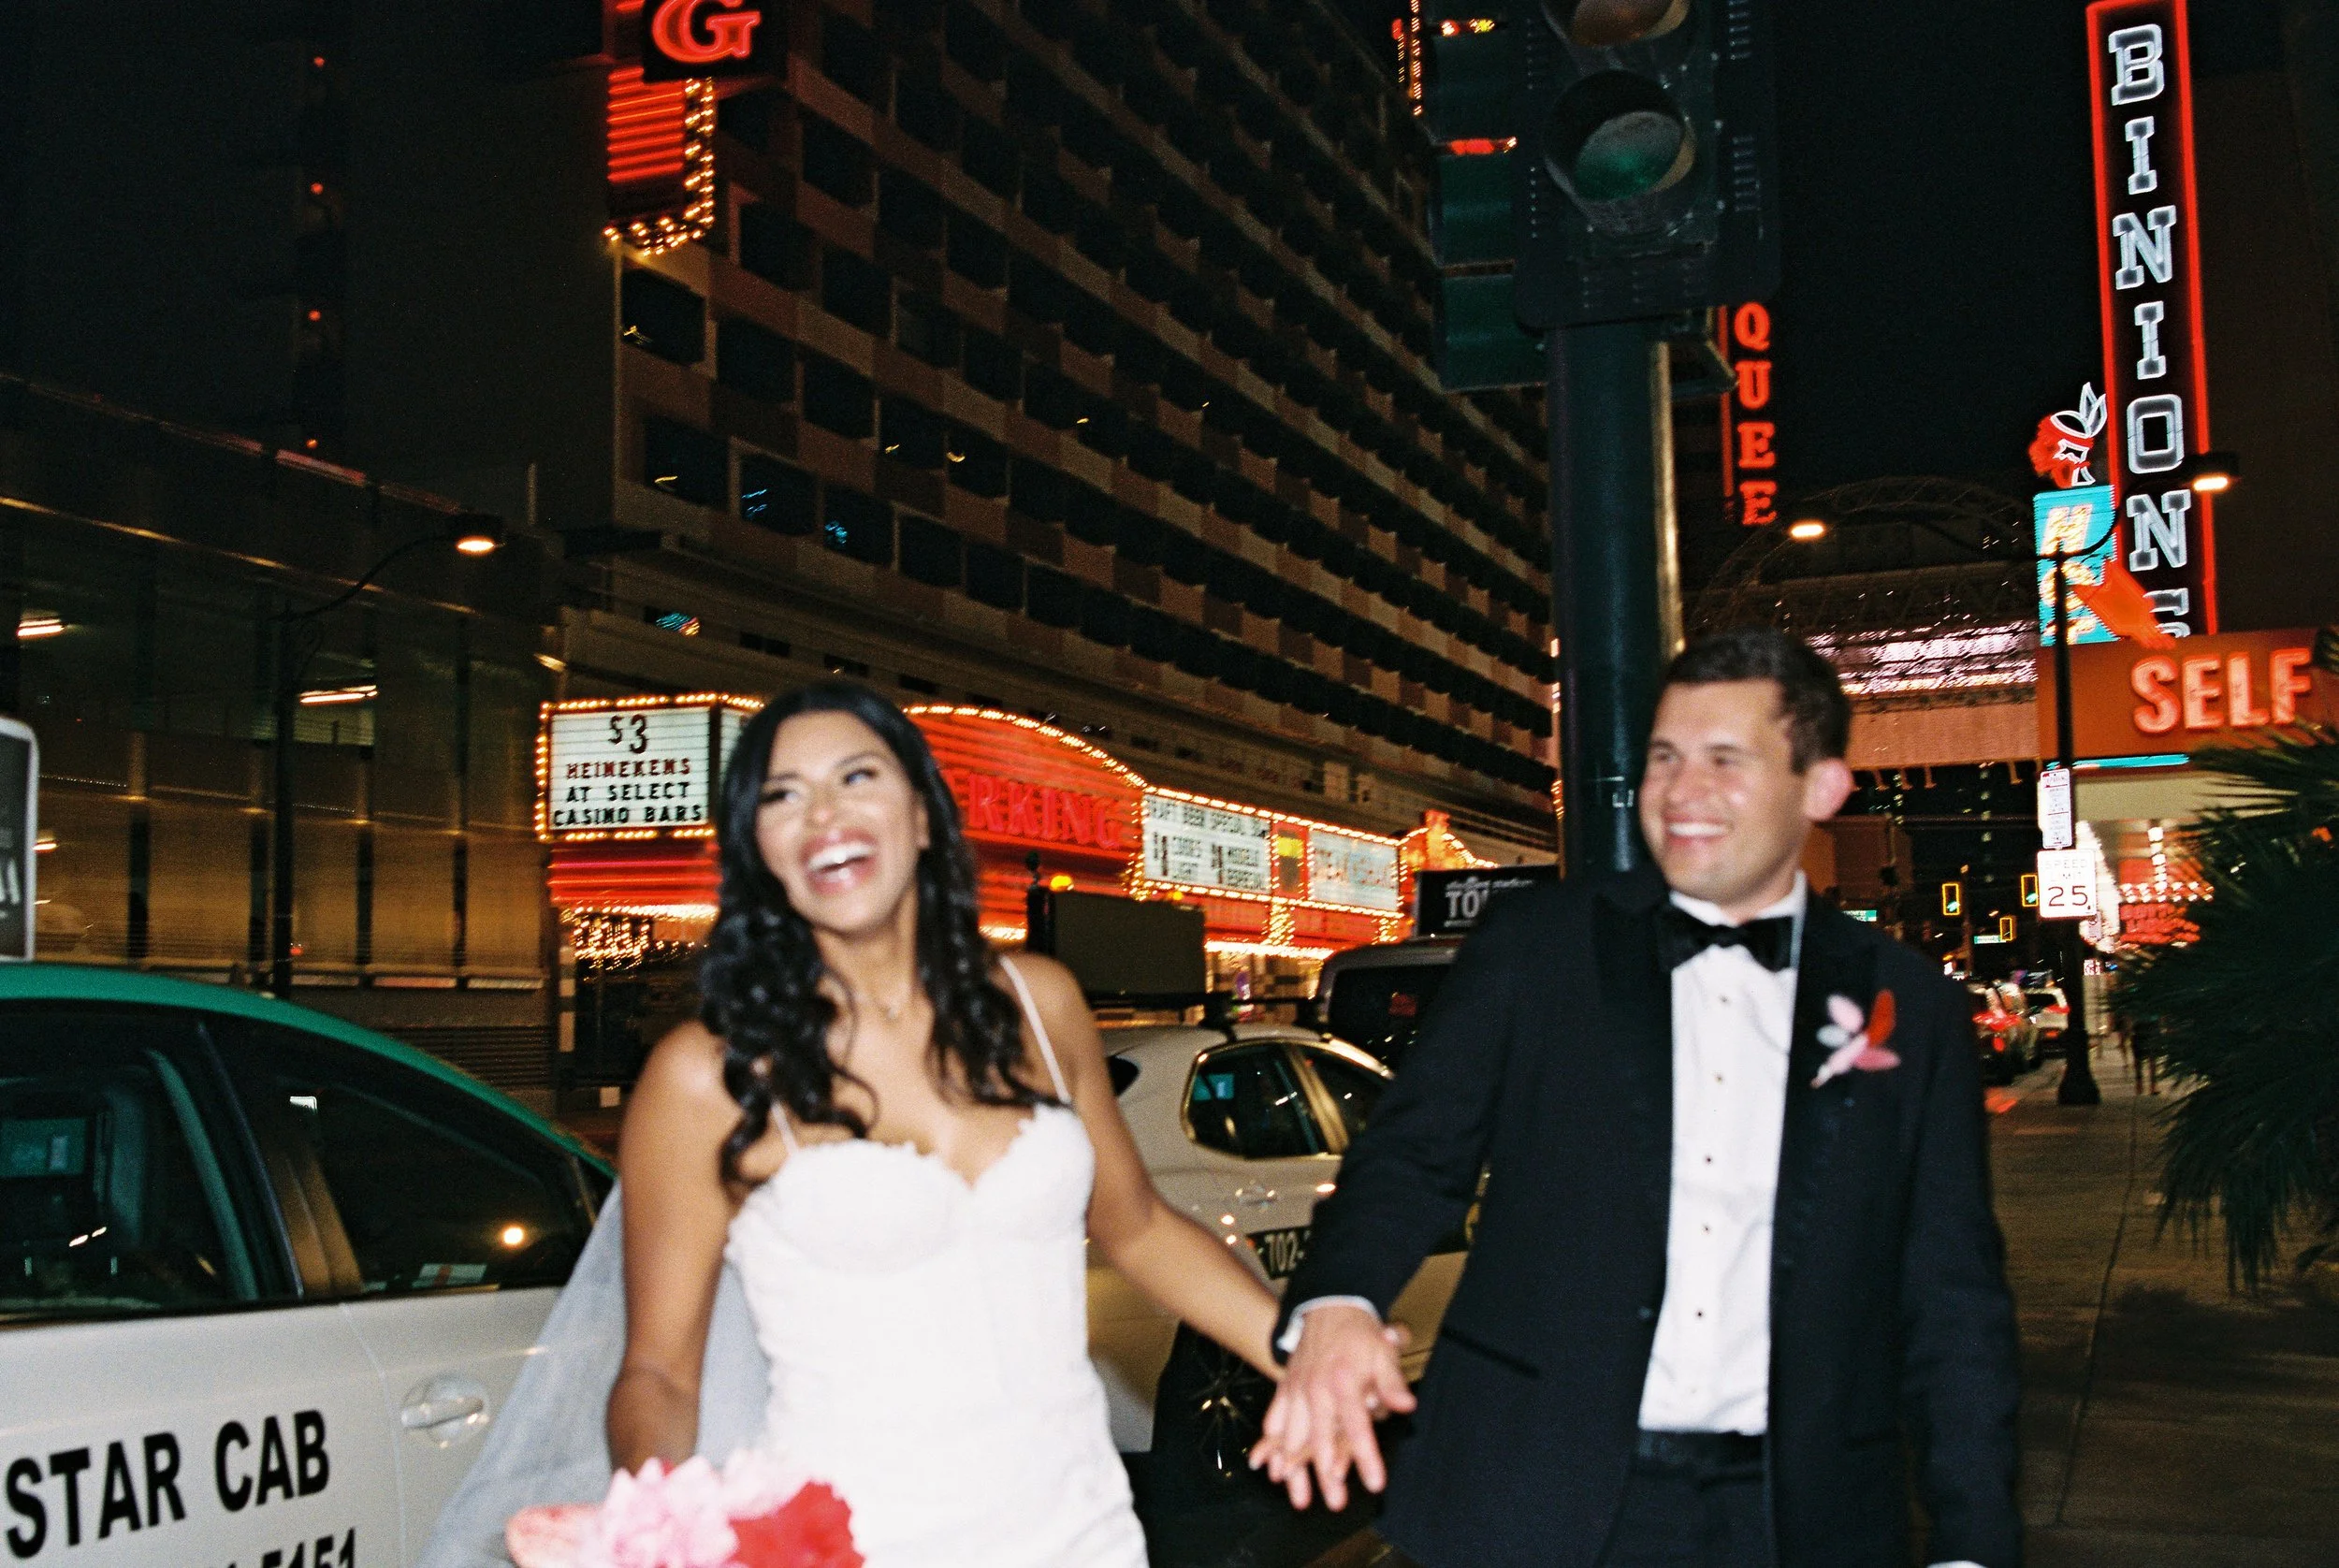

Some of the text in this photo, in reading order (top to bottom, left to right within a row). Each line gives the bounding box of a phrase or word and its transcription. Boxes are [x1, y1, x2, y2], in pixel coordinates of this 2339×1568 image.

[2131, 647, 2312, 733] SELF
[566, 758, 690, 779] HEINEKENS
[566, 782, 690, 803] AT SELECT
[554, 805, 702, 827] CASINO BARS
[2048, 885, 2088, 907] 25
[5, 1409, 329, 1559] STAR CAB
